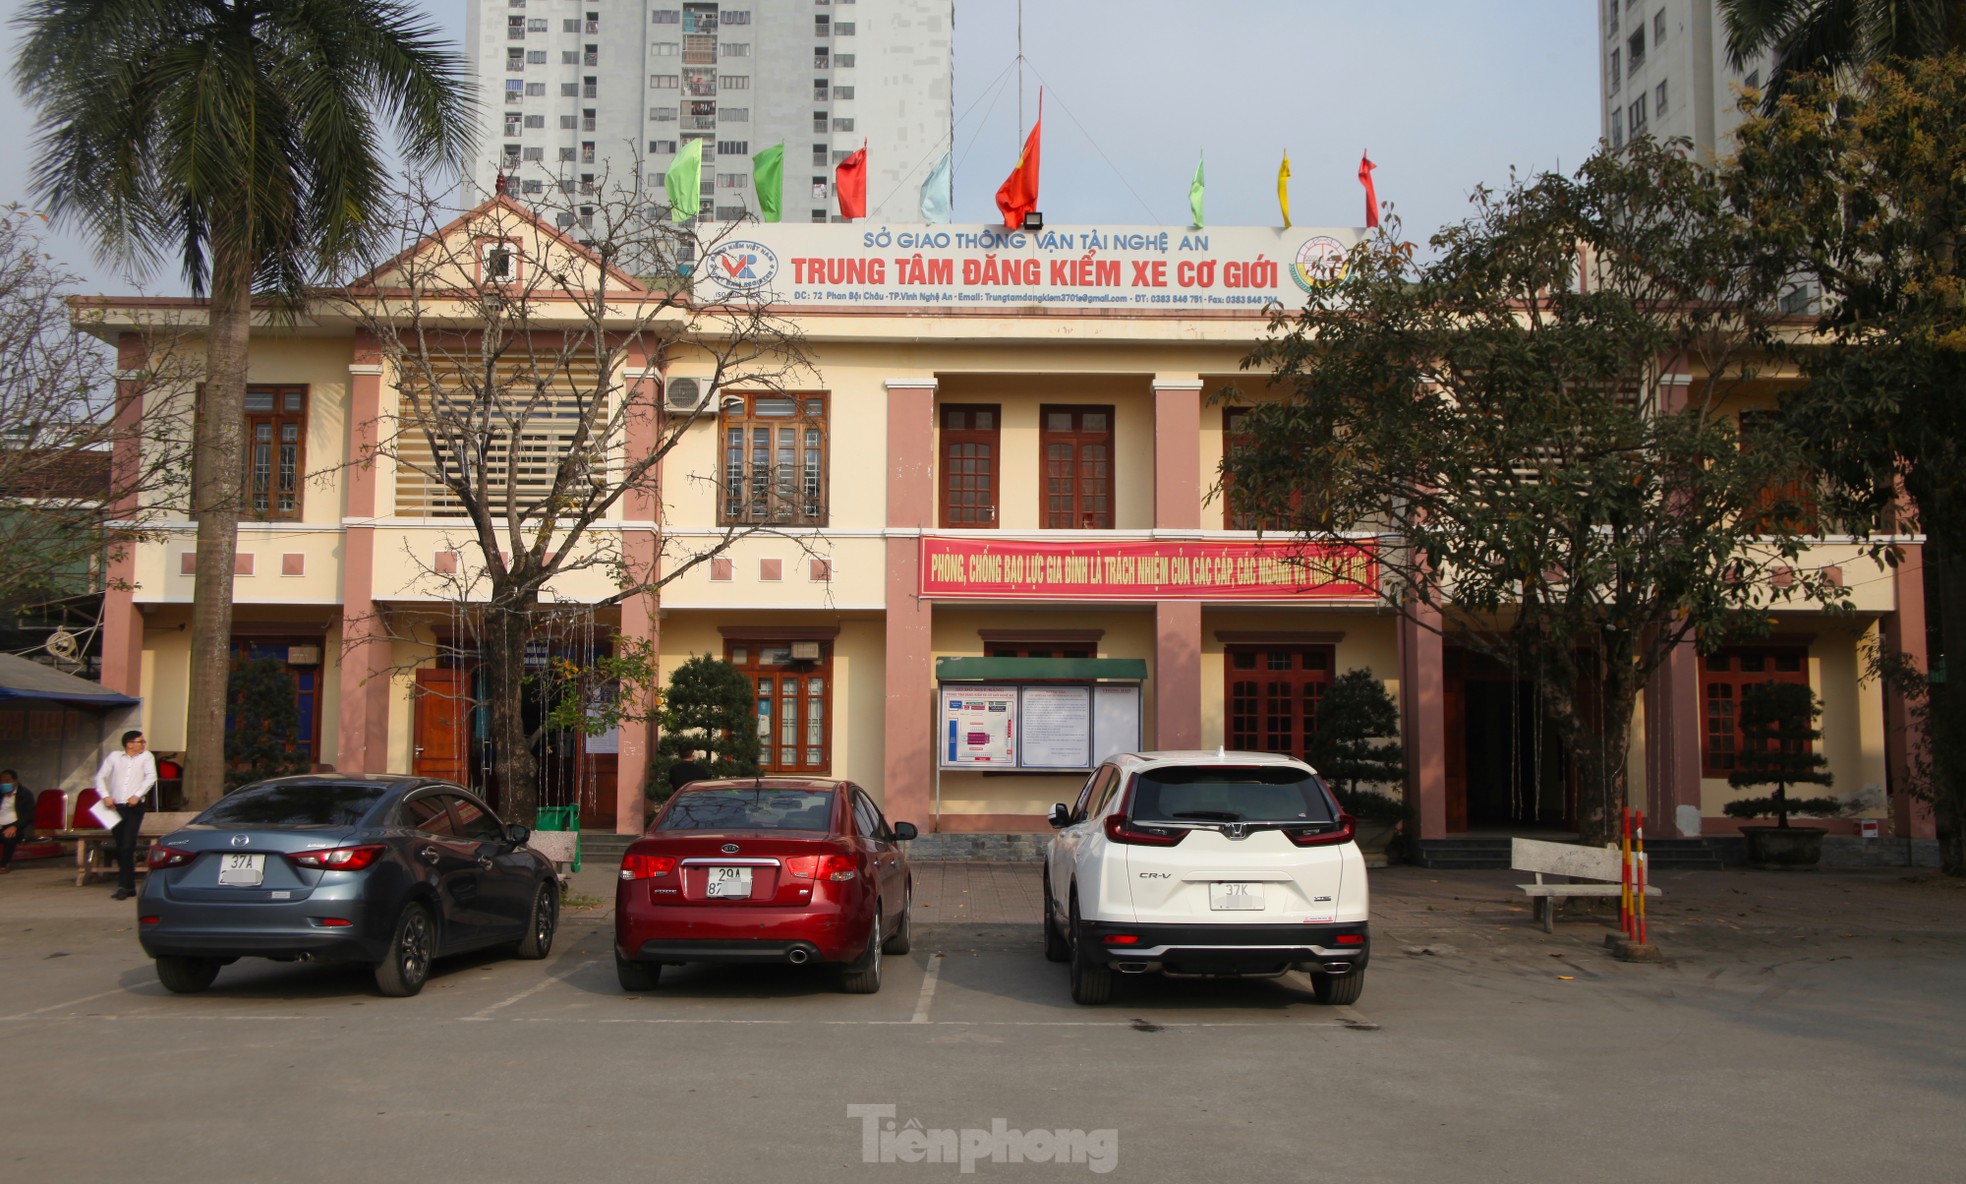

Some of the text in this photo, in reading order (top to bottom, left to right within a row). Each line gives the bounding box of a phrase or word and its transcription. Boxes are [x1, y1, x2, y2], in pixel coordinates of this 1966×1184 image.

[864, 226, 1208, 254] SỞ GIAO THÔNG VẬN TẢI NGHỆ AN
[760, 249, 774, 262] NAM
[791, 249, 1278, 288] TRUNG TÂM ĐĂNG KIỂM XE CƠ GIỚI
[813, 291, 823, 300] 72
[826, 291, 847, 300] Phan
[863, 291, 884, 300] Châu
[919, 292, 940, 303] Nghệ
[941, 292, 953, 301] An
[931, 547, 967, 586] PHÒNG,
[969, 544, 1002, 583] CHỐNG
[1004, 555, 1023, 590] BẠO
[1026, 552, 1044, 590] LỰC
[1046, 555, 1063, 584] GIA
[1065, 550, 1088, 584] ĐÌNH
[1090, 550, 1102, 584] LÀ
[1104, 550, 1135, 585] TRÁCH
[1137, 551, 1169, 591] NHIỆM
[1171, 547, 1191, 585] CỦA
[1192, 551, 1212, 585] CÁC
[1214, 547, 1236, 588] CẤP,
[1237, 551, 1257, 585] CÁC
[231, 854, 253, 869] 37A
[719, 868, 740, 882] 29A
[1225, 884, 1248, 896] 37K
